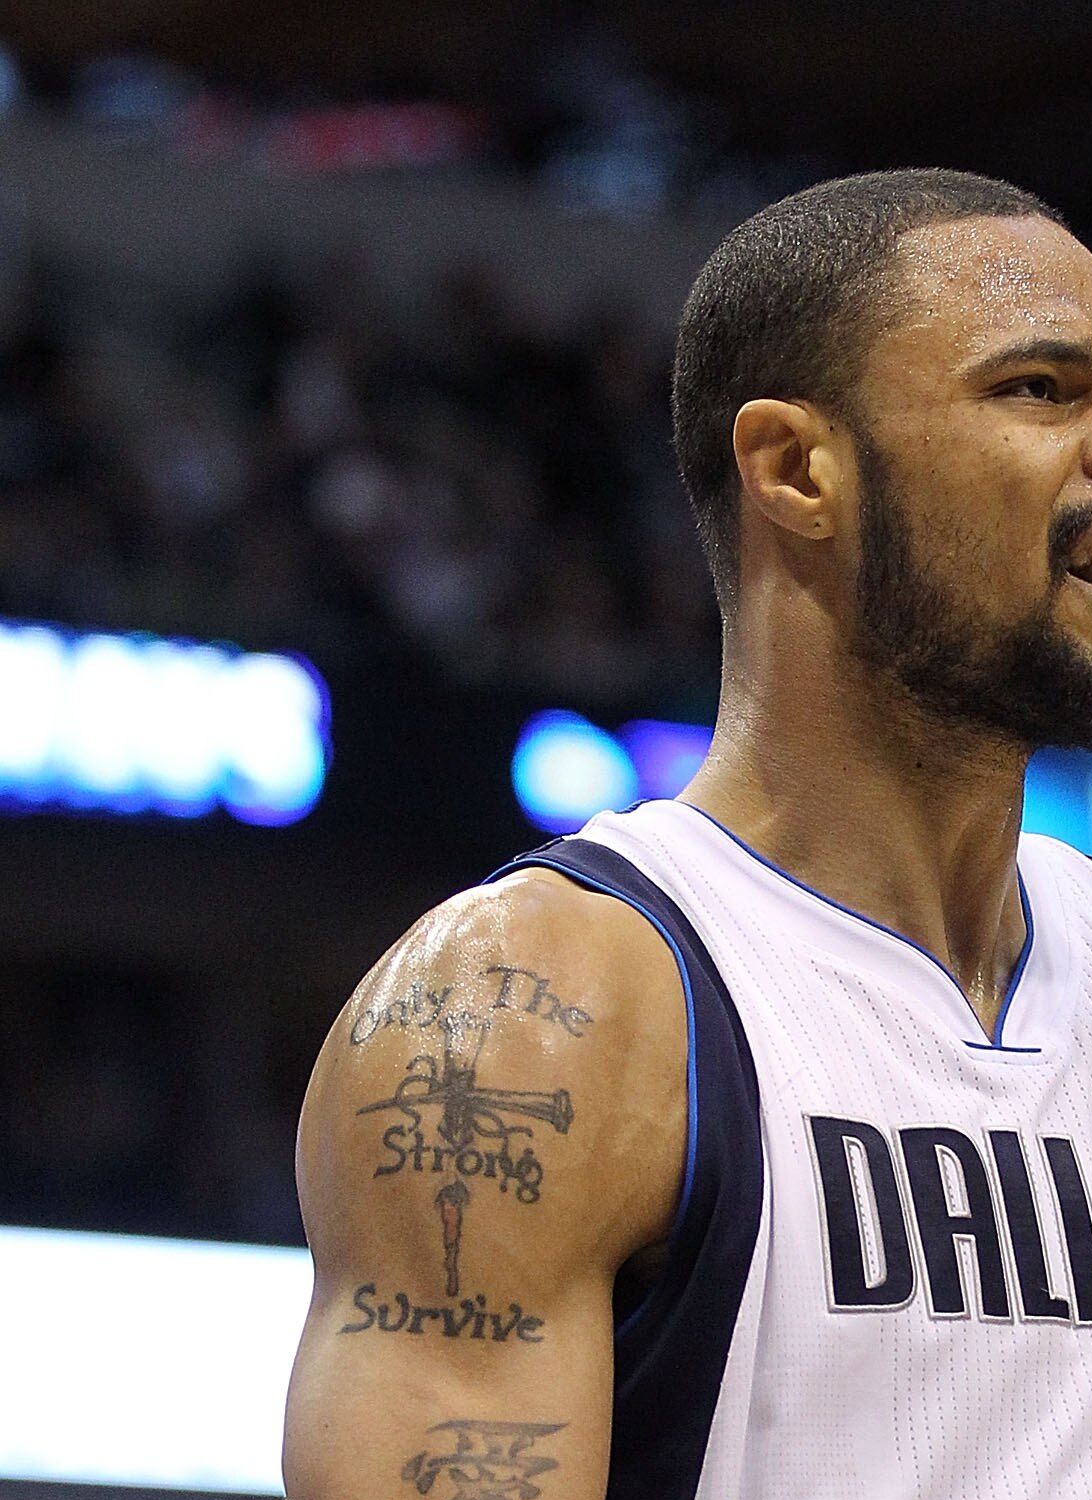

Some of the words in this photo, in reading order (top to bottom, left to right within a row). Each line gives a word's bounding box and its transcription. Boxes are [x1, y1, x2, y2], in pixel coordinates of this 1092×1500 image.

[479, 964, 595, 1038] The
[373, 1125, 544, 1204] Strong
[336, 1283, 546, 1344] Survive
